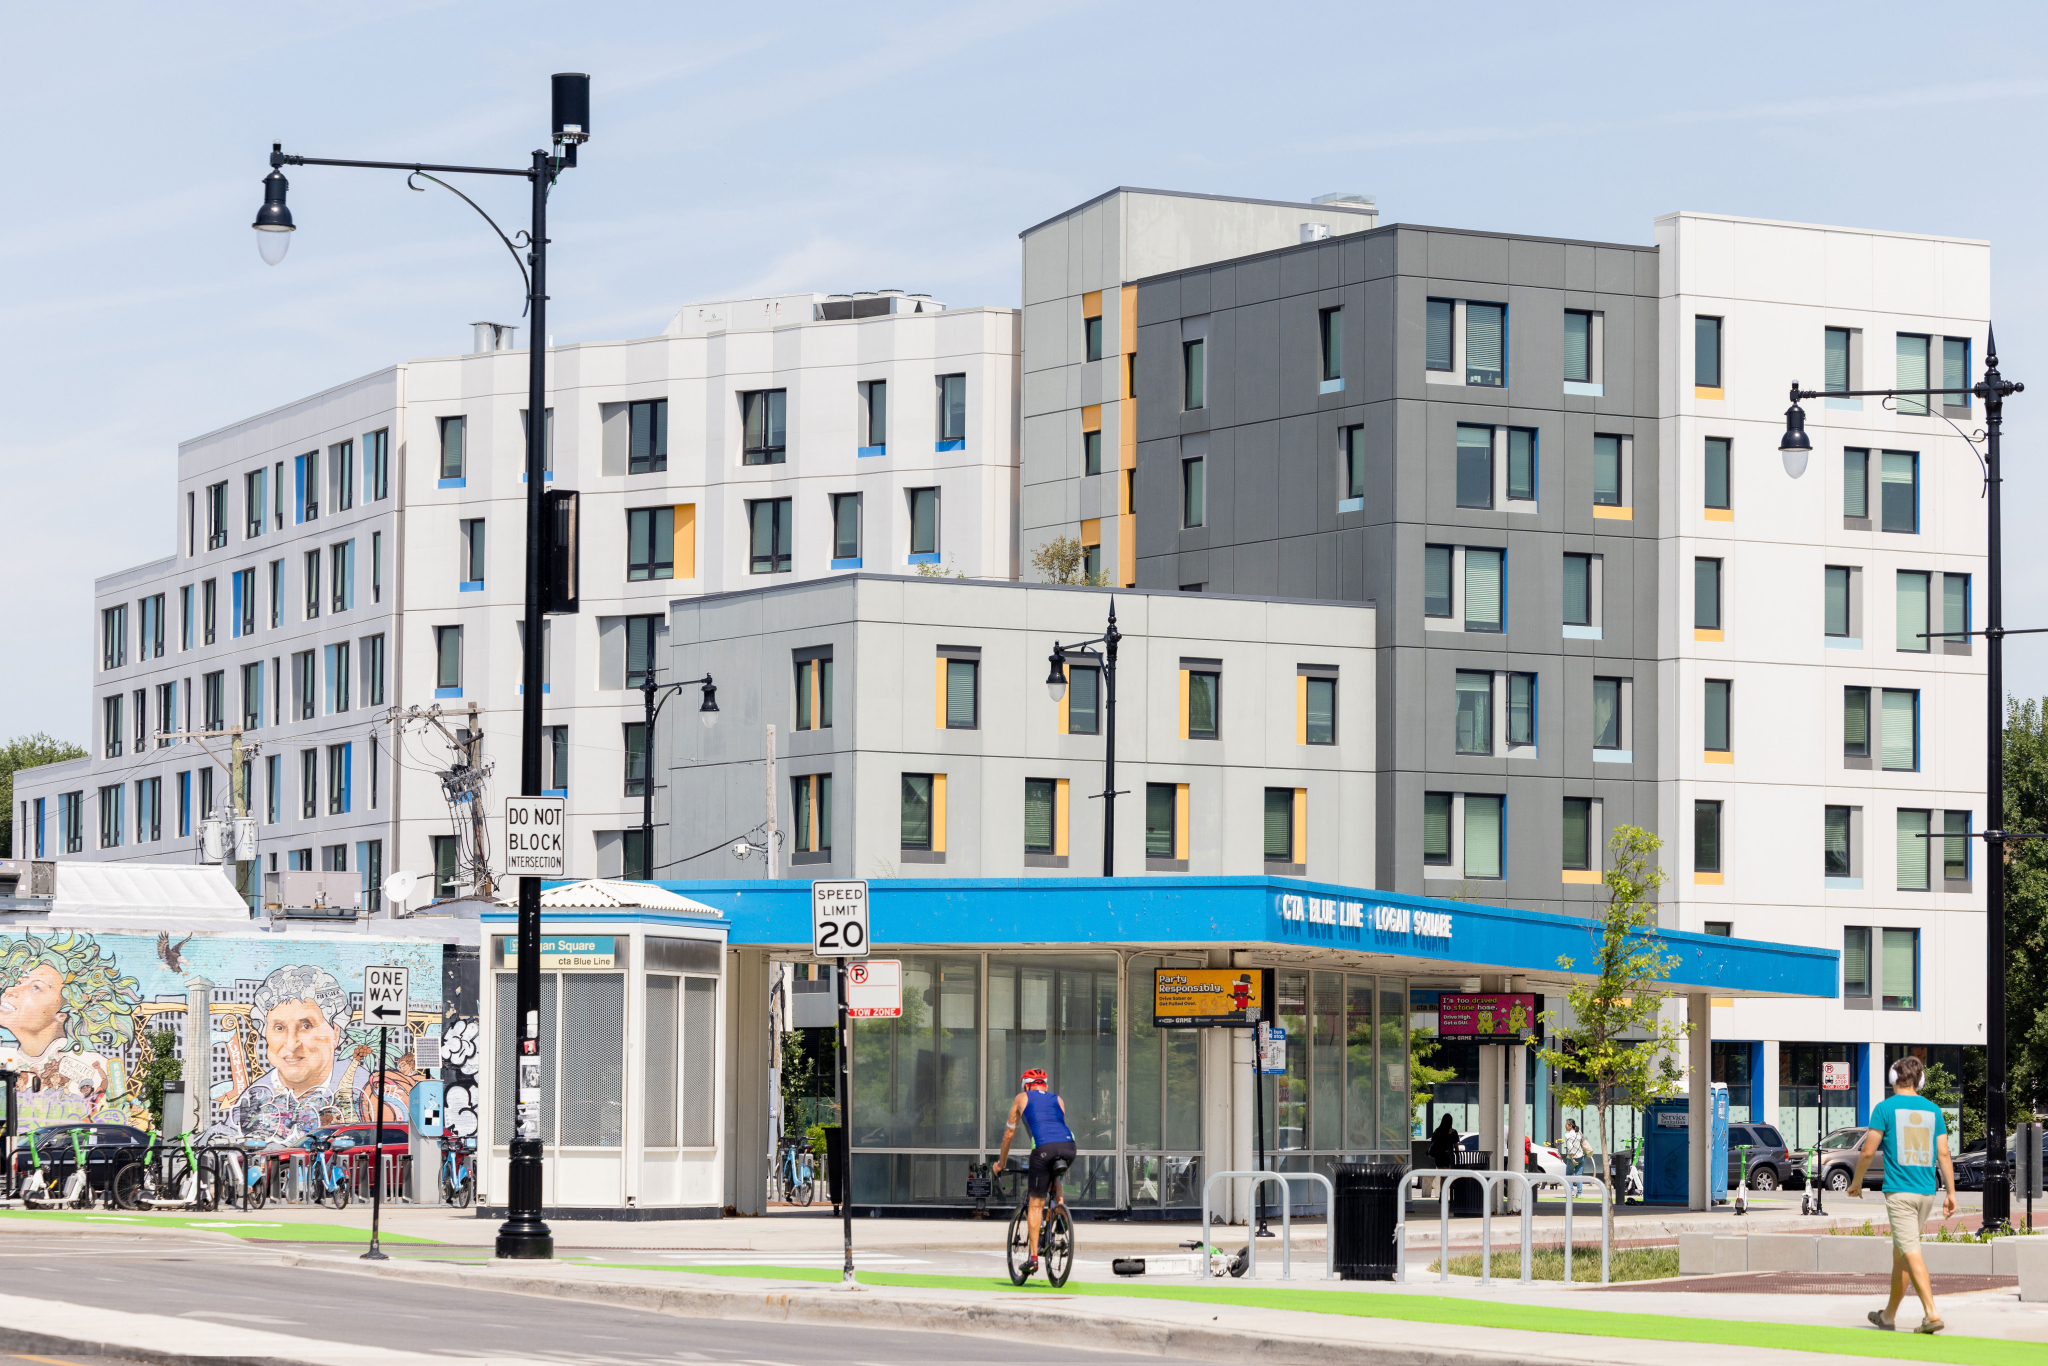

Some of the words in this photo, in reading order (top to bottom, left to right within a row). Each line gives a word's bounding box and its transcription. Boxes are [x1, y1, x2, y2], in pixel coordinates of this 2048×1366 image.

[509, 808, 528, 825] DO
[534, 808, 562, 826] NOT
[509, 833, 562, 851] BLOCK
[508, 856, 562, 868] INTERSECTION
[818, 889, 863, 900] SPEED
[823, 905, 858, 916] LIMIT
[1282, 894, 1305, 921] CTA
[1308, 897, 1336, 925] BLUE
[1339, 902, 1364, 928] LINE
[1375, 906, 1410, 933] LOGAN
[1413, 910, 1452, 938] SQUARE
[818, 920, 864, 948] 20
[558, 940, 596, 953] Square
[574, 958, 592, 966] Blue
[594, 958, 610, 966] Line
[370, 971, 402, 986] ONE
[1159, 974, 1187, 984] Party
[369, 988, 403, 1002] WAY
[1159, 983, 1224, 994] Responsibly.
[872, 1008, 896, 1016] ZONE
[1904, 1152, 1930, 1165] 70.3
